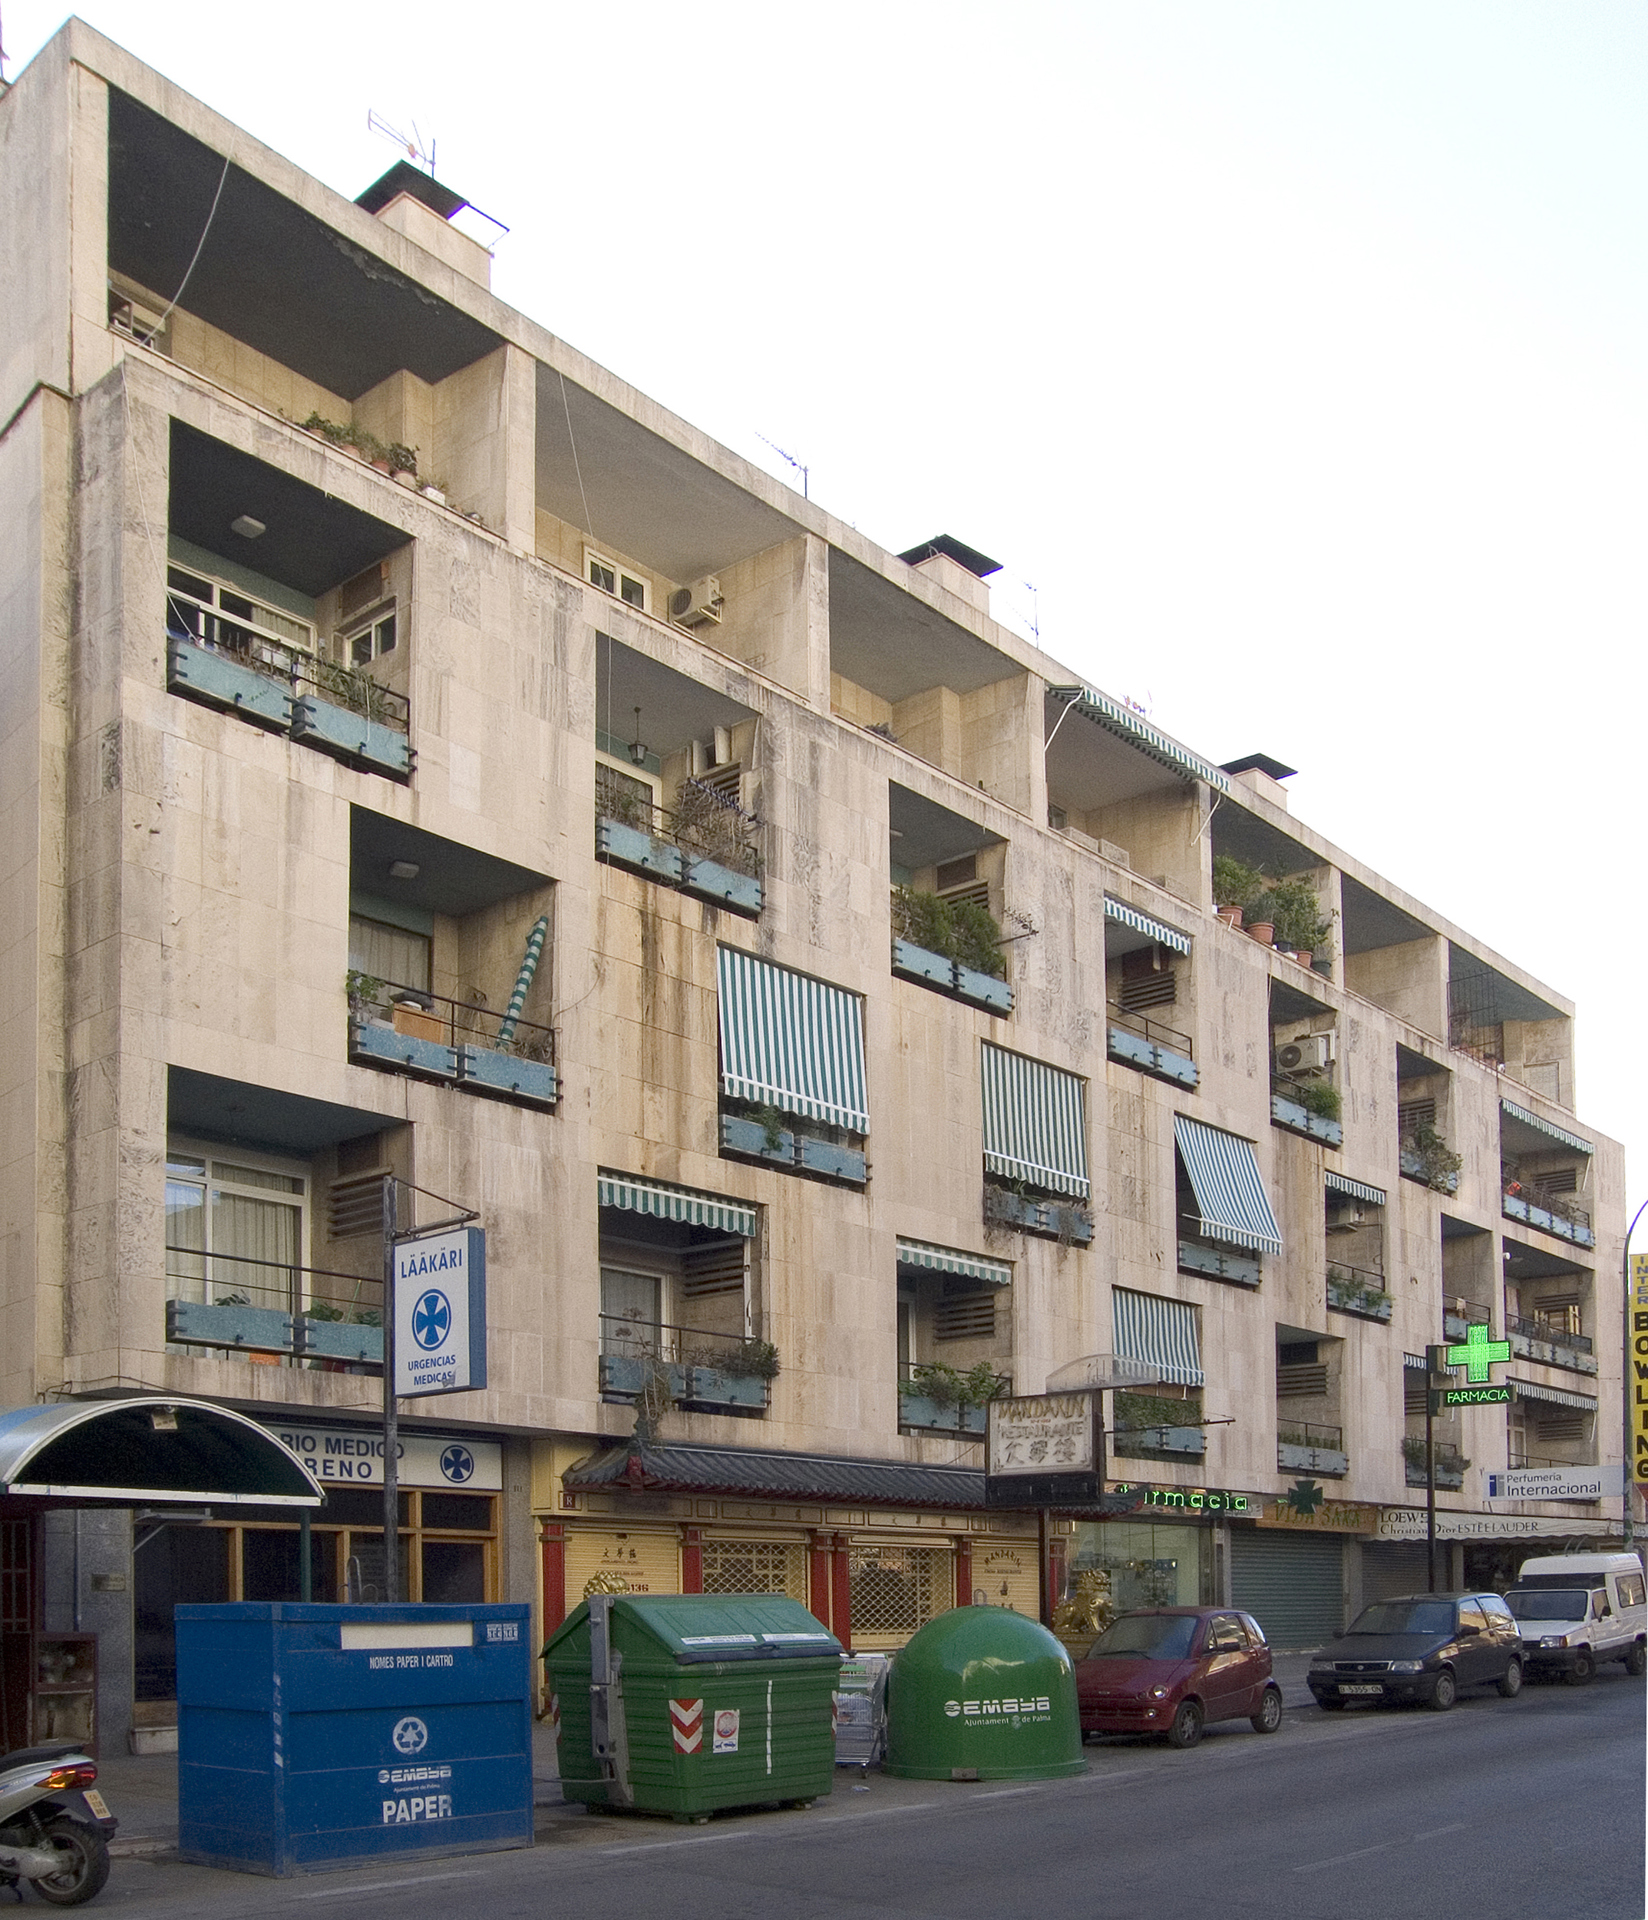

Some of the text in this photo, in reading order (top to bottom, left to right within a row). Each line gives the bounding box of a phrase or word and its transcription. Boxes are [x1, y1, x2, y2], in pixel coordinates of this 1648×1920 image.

[401, 1247, 462, 1279] LÄÄKÄRI
[408, 1354, 456, 1371] URGENCIAS
[413, 1371, 453, 1386] MEDICAS
[1447, 1389, 1510, 1404] FARMACIA
[998, 1395, 1085, 1422] MANDARIN
[1507, 1481, 1601, 1497] Internacional
[566, 1496, 573, 1506] R
[369, 1656, 394, 1669] NOMES
[396, 1655, 419, 1668] PAPER
[964, 1714, 1051, 1727] Ajuntament de Palma
[382, 1794, 452, 1824] PAPER
